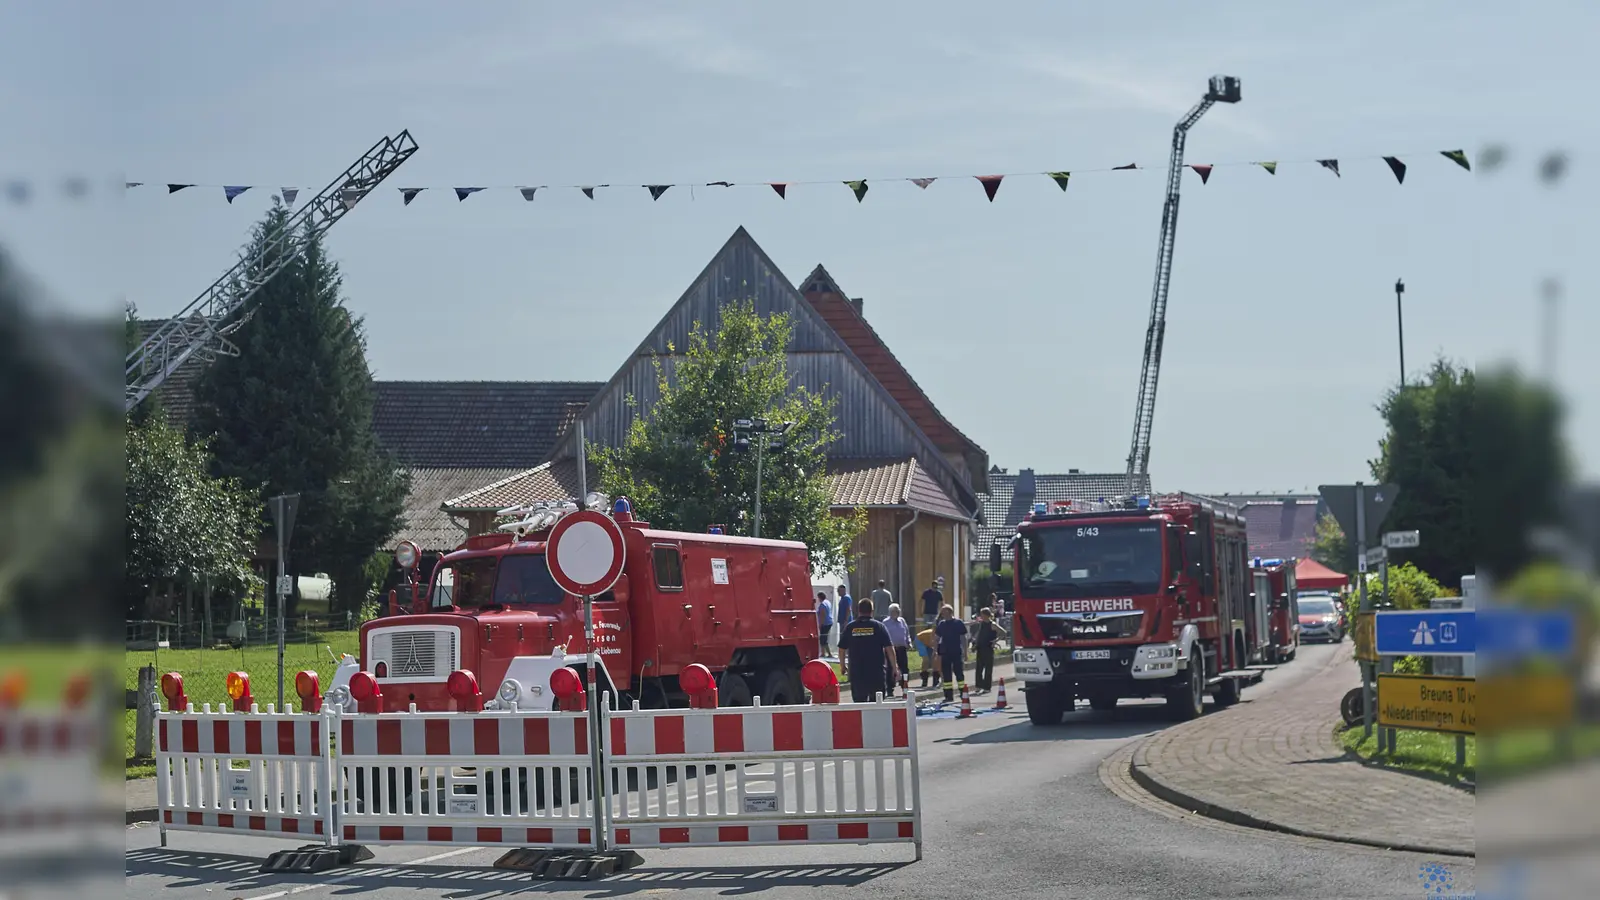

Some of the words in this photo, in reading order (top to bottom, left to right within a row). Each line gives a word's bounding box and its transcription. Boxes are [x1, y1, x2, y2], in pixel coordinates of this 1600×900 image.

[1076, 527, 1099, 537] 5/43
[1044, 598, 1133, 613] FEUERWEHR
[1072, 624, 1107, 633] MAN
[1443, 626, 1453, 638] 44
[1420, 684, 1453, 703] Breuna
[1456, 686, 1466, 703] 10
[1460, 709, 1466, 725] 4
